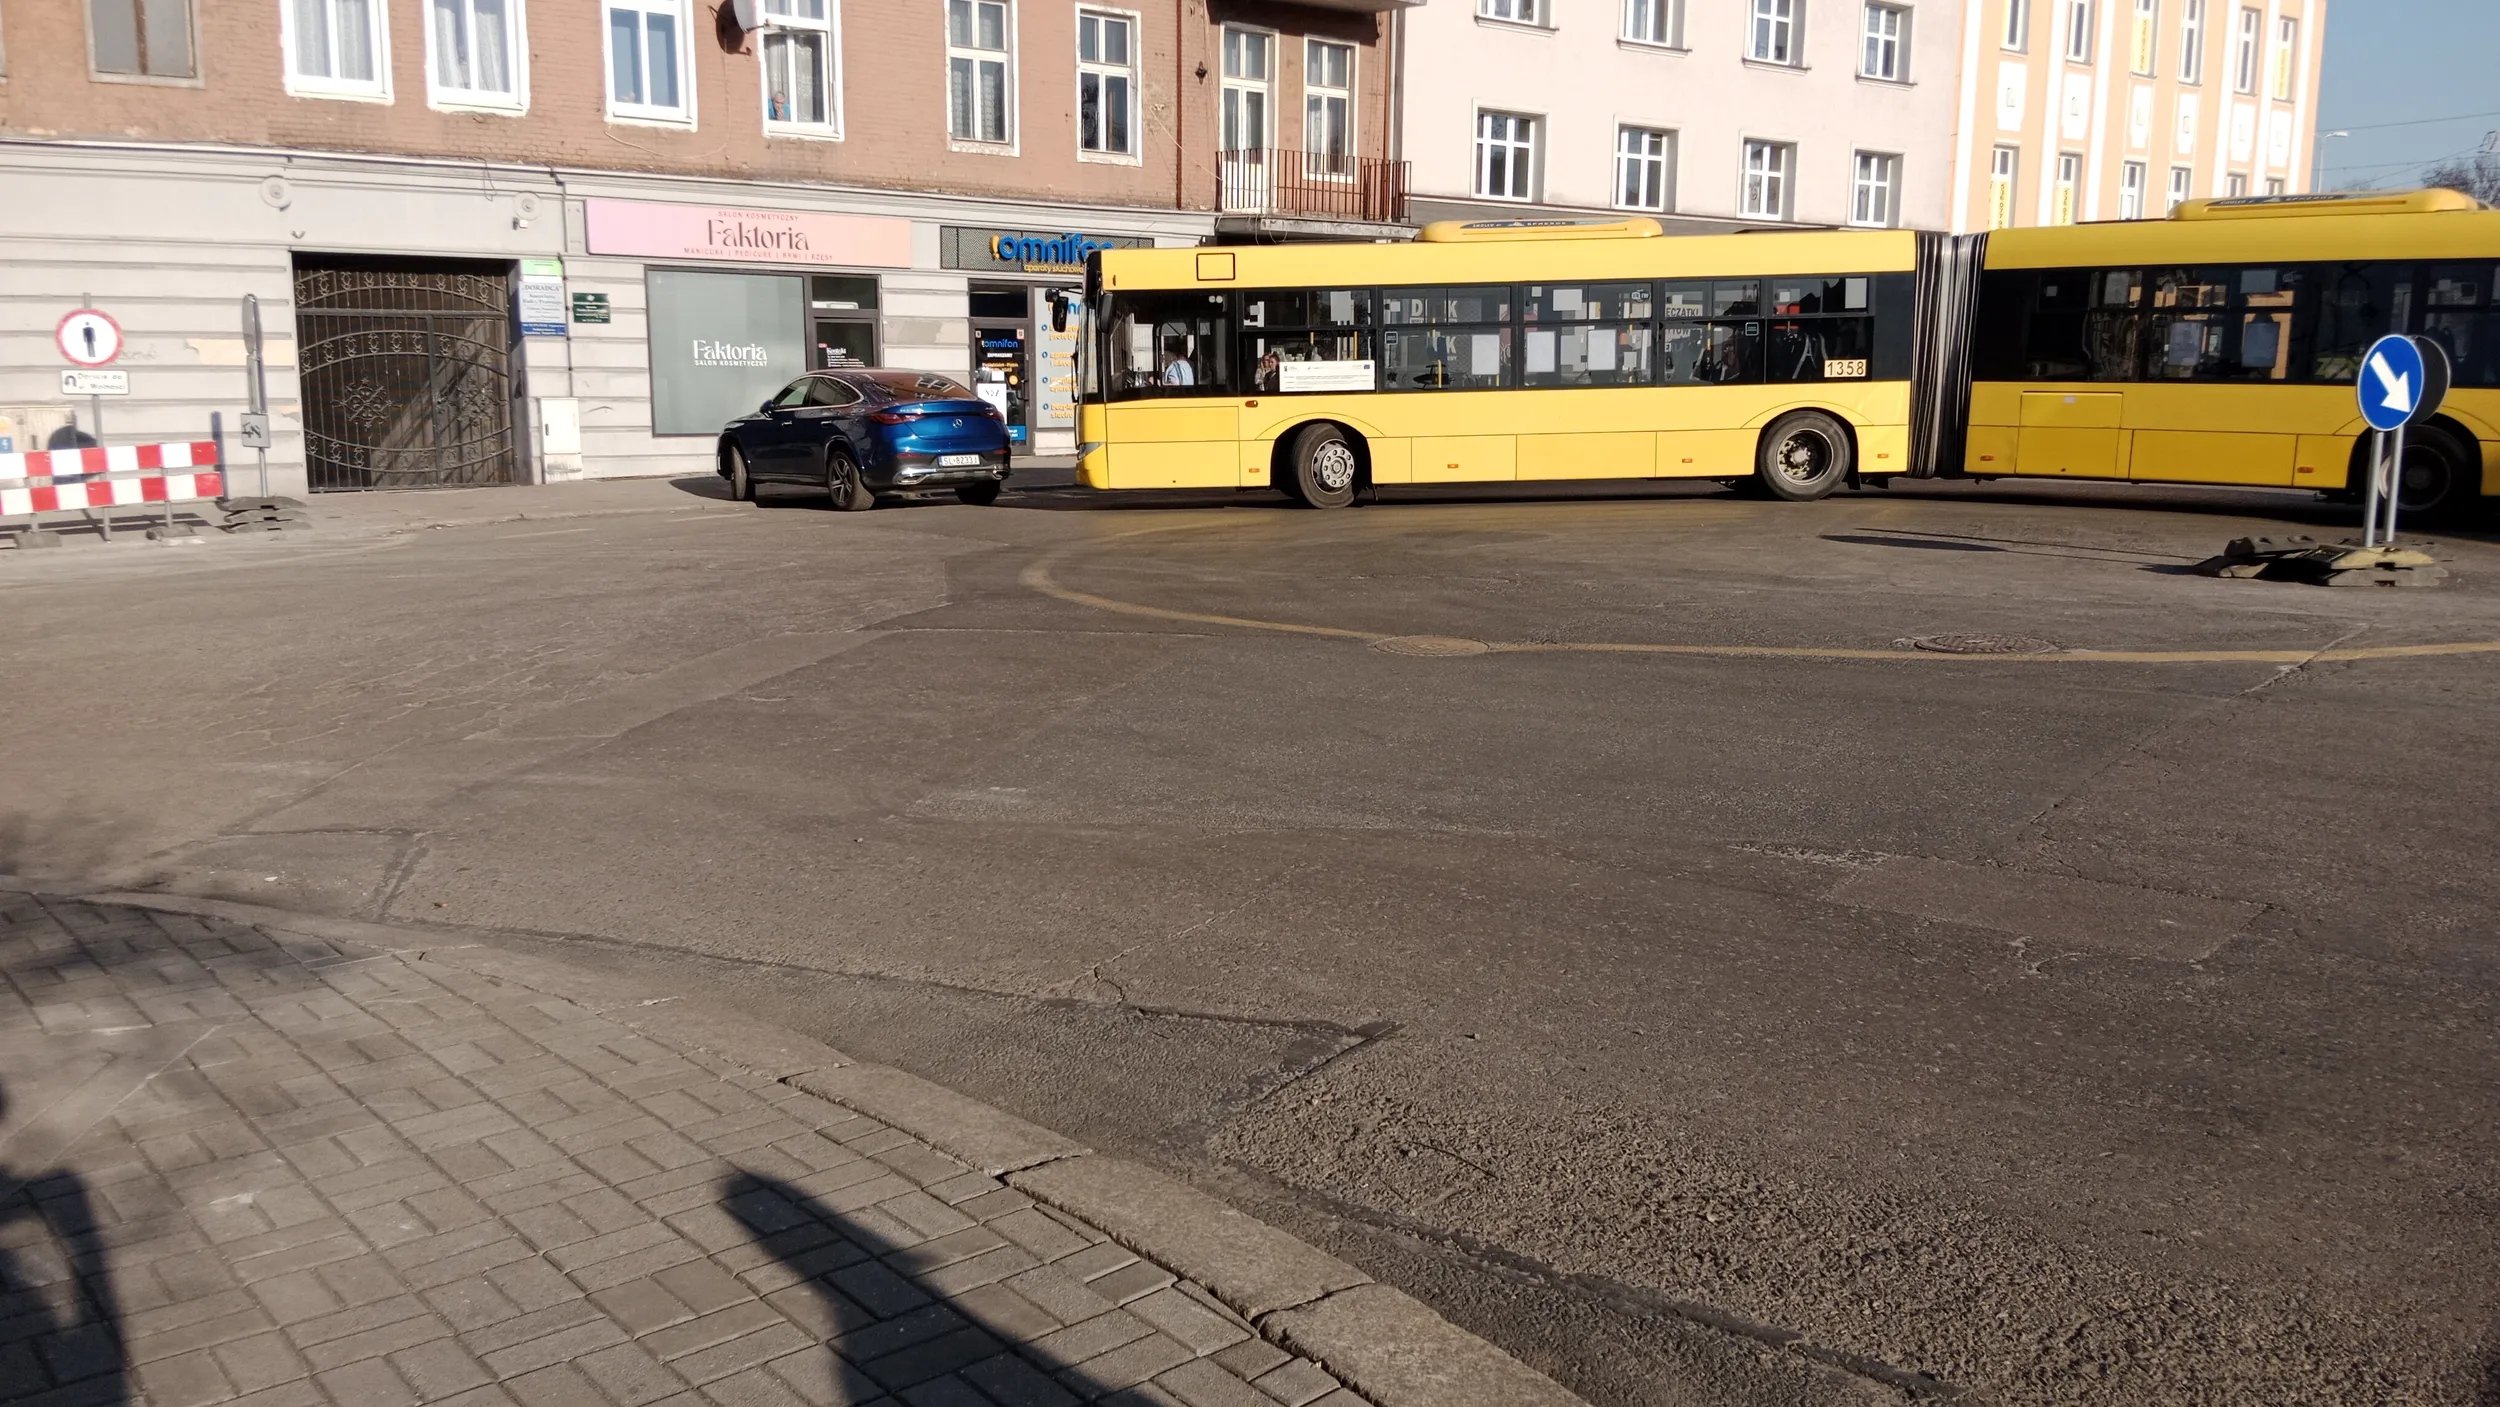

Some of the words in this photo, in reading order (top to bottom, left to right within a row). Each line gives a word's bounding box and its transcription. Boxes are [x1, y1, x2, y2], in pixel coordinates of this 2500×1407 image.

[717, 211, 743, 219] SALON
[746, 212, 799, 222] KOSMETYCZNY
[708, 218, 810, 251] Faktoria
[684, 247, 724, 256] MANICURE
[735, 249, 772, 258] PEDICURE
[811, 253, 833, 262] RZĘSY
[1023, 263, 1052, 274] aparaty
[692, 339, 768, 361] Faktoria
[1827, 361, 1865, 376] 1358
